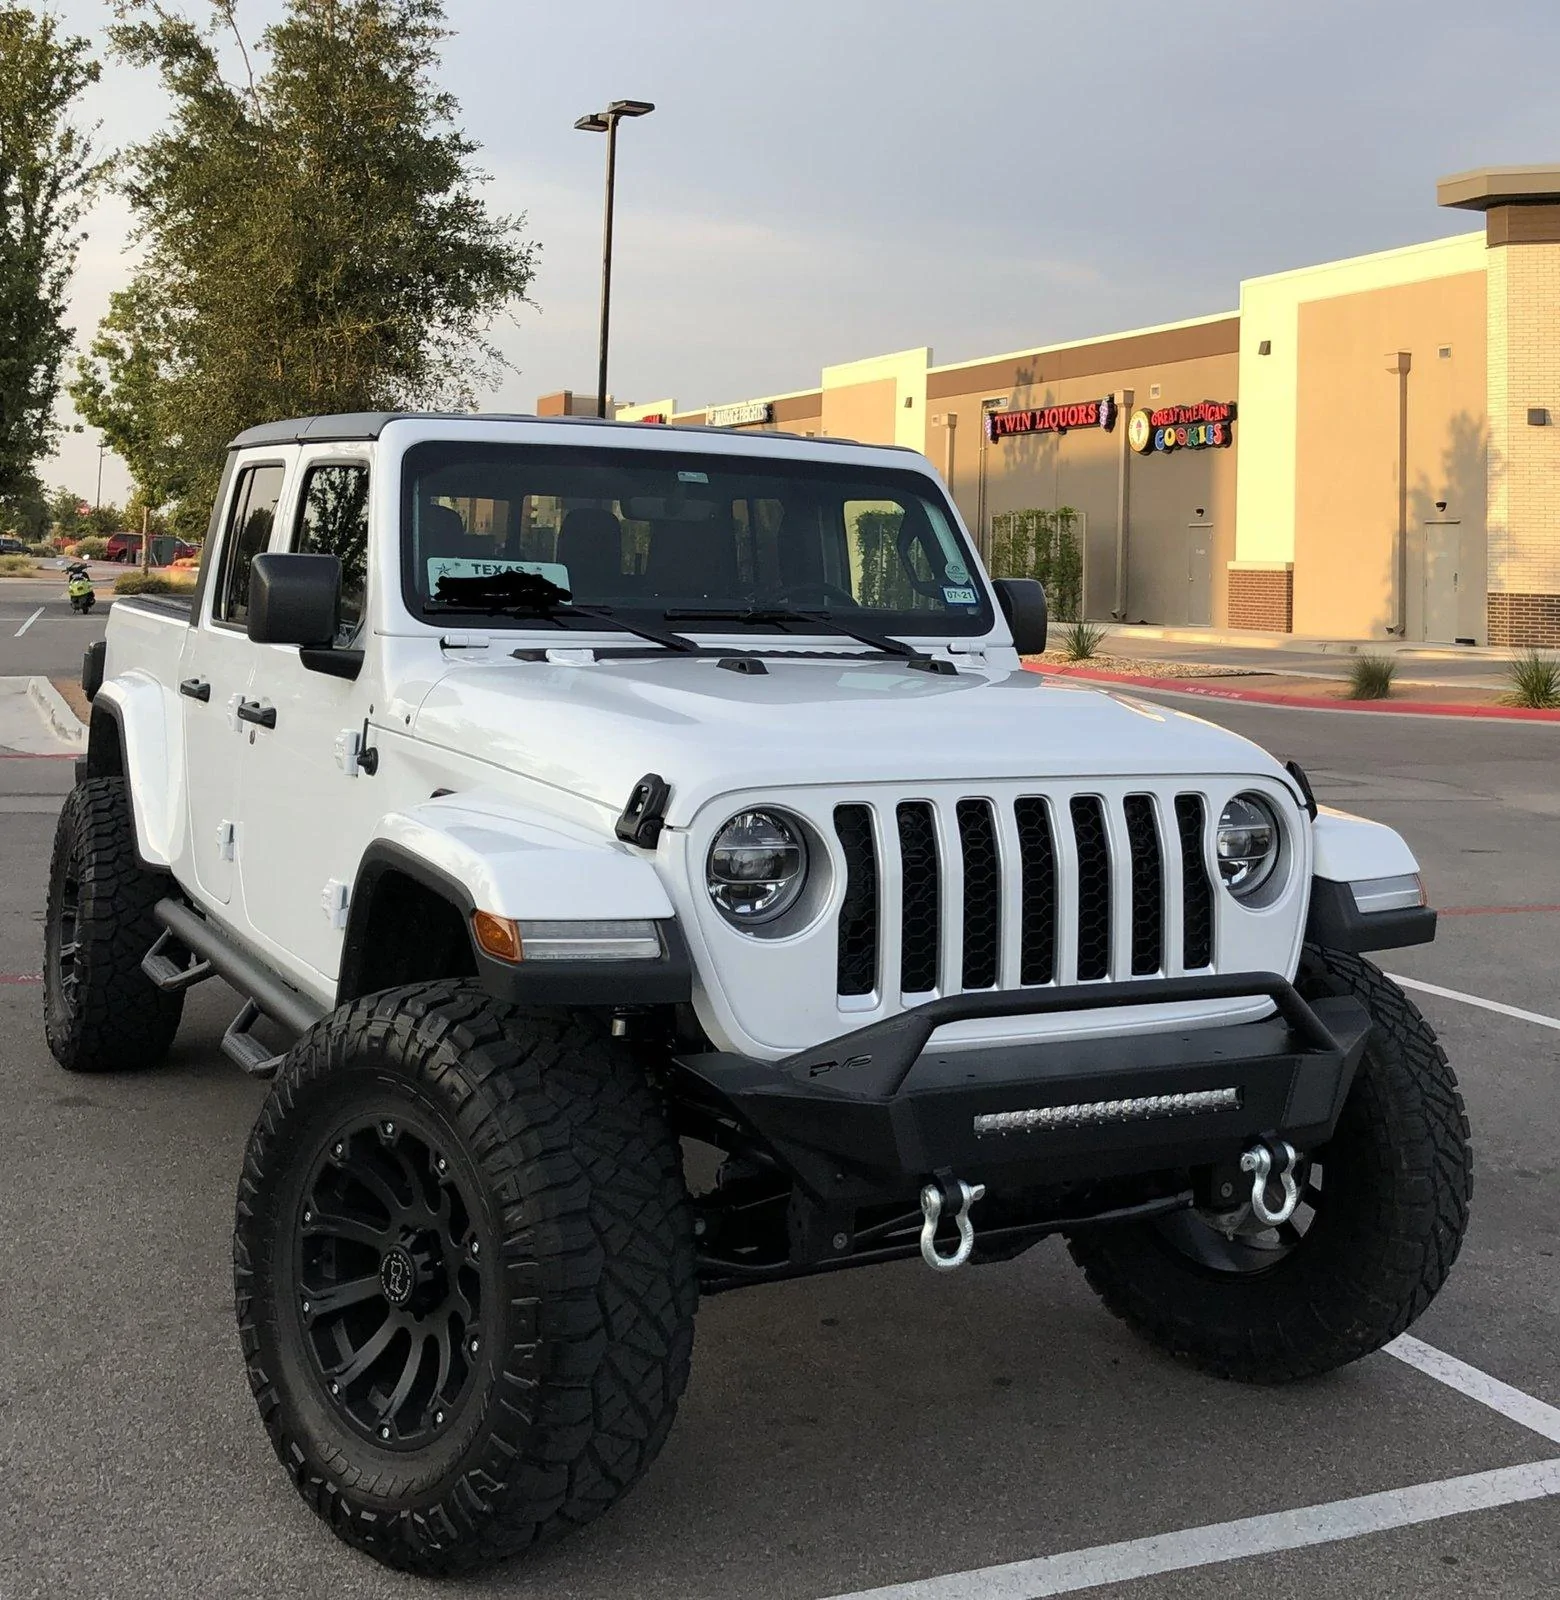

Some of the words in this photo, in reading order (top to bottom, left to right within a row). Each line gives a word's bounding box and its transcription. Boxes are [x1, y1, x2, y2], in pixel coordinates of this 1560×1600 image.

[995, 412, 1032, 434] TWIN
[1035, 404, 1096, 431] LIQUORS
[1151, 408, 1179, 426] GREAT
[1179, 403, 1228, 423] AMERICAN
[1155, 423, 1222, 450] COOKIES
[471, 563, 525, 575] TEXAS
